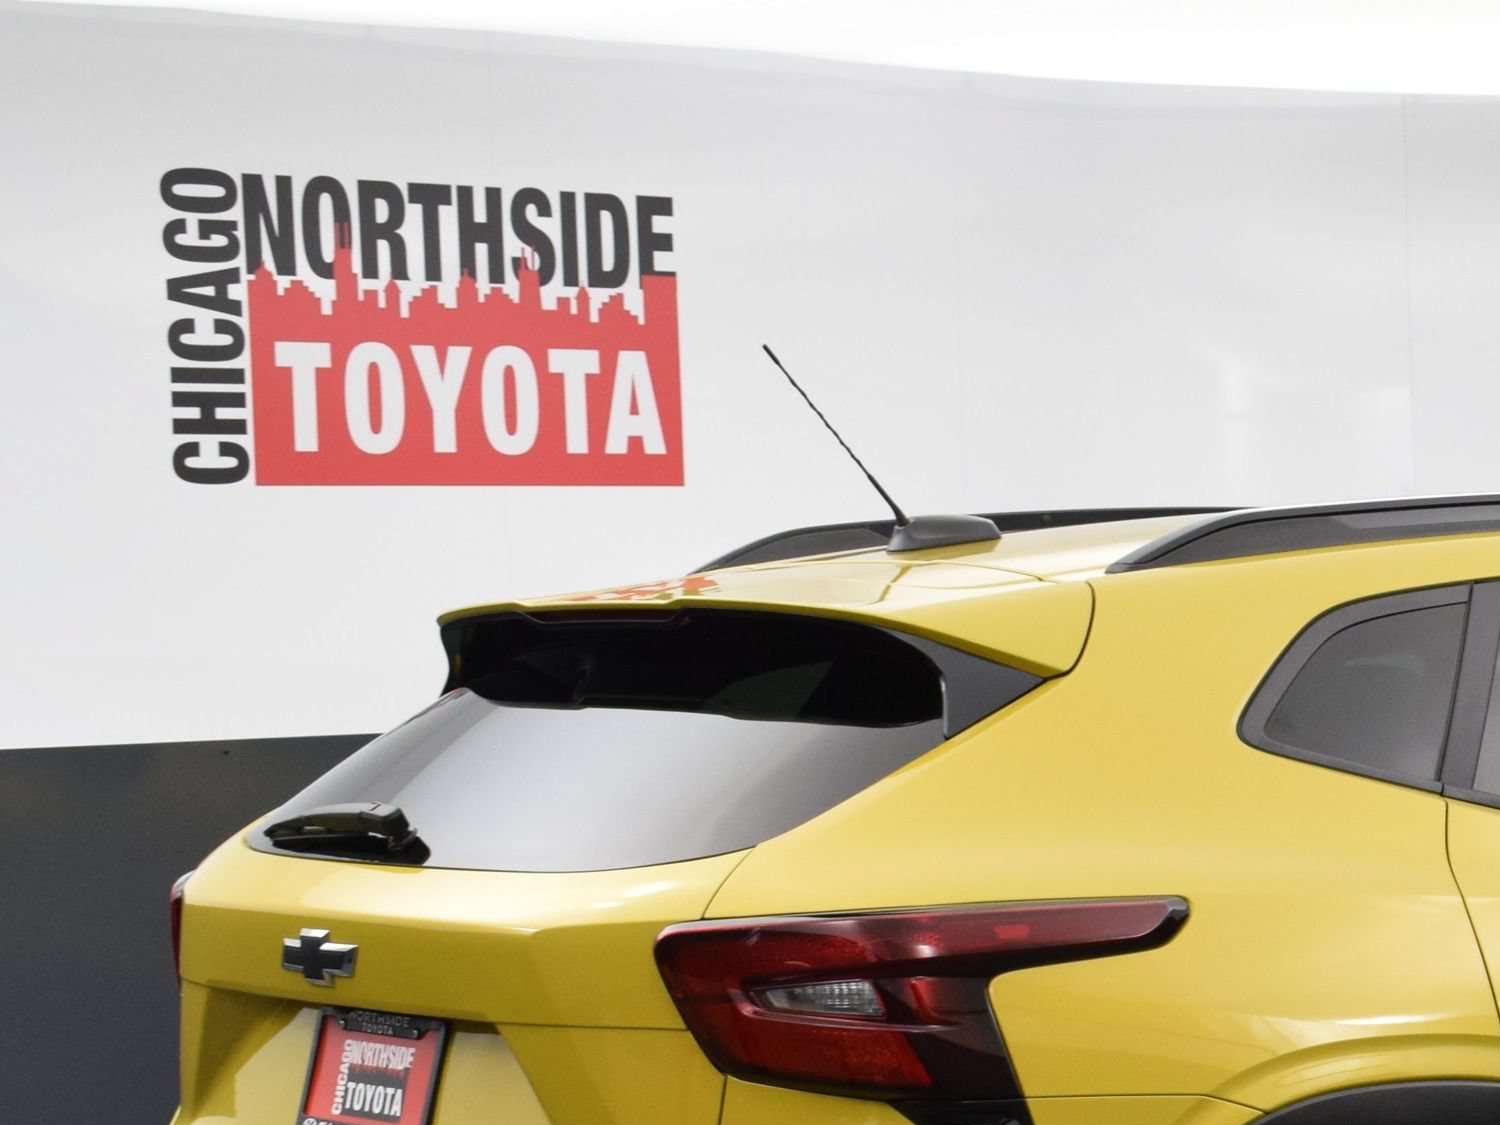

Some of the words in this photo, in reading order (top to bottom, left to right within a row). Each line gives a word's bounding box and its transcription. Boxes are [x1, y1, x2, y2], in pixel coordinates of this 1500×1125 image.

[241, 173, 677, 290] NORTHSIDE
[159, 167, 250, 485] CHICAGO
[274, 341, 667, 455] TOYOTA
[350, 1010, 411, 1028] NORTHSIDE
[362, 1022, 394, 1035] TOYOTA
[331, 1039, 353, 1116] CHICAGO
[348, 1041, 416, 1070] NORTHSIDE
[345, 1081, 403, 1117] TOYOTA
